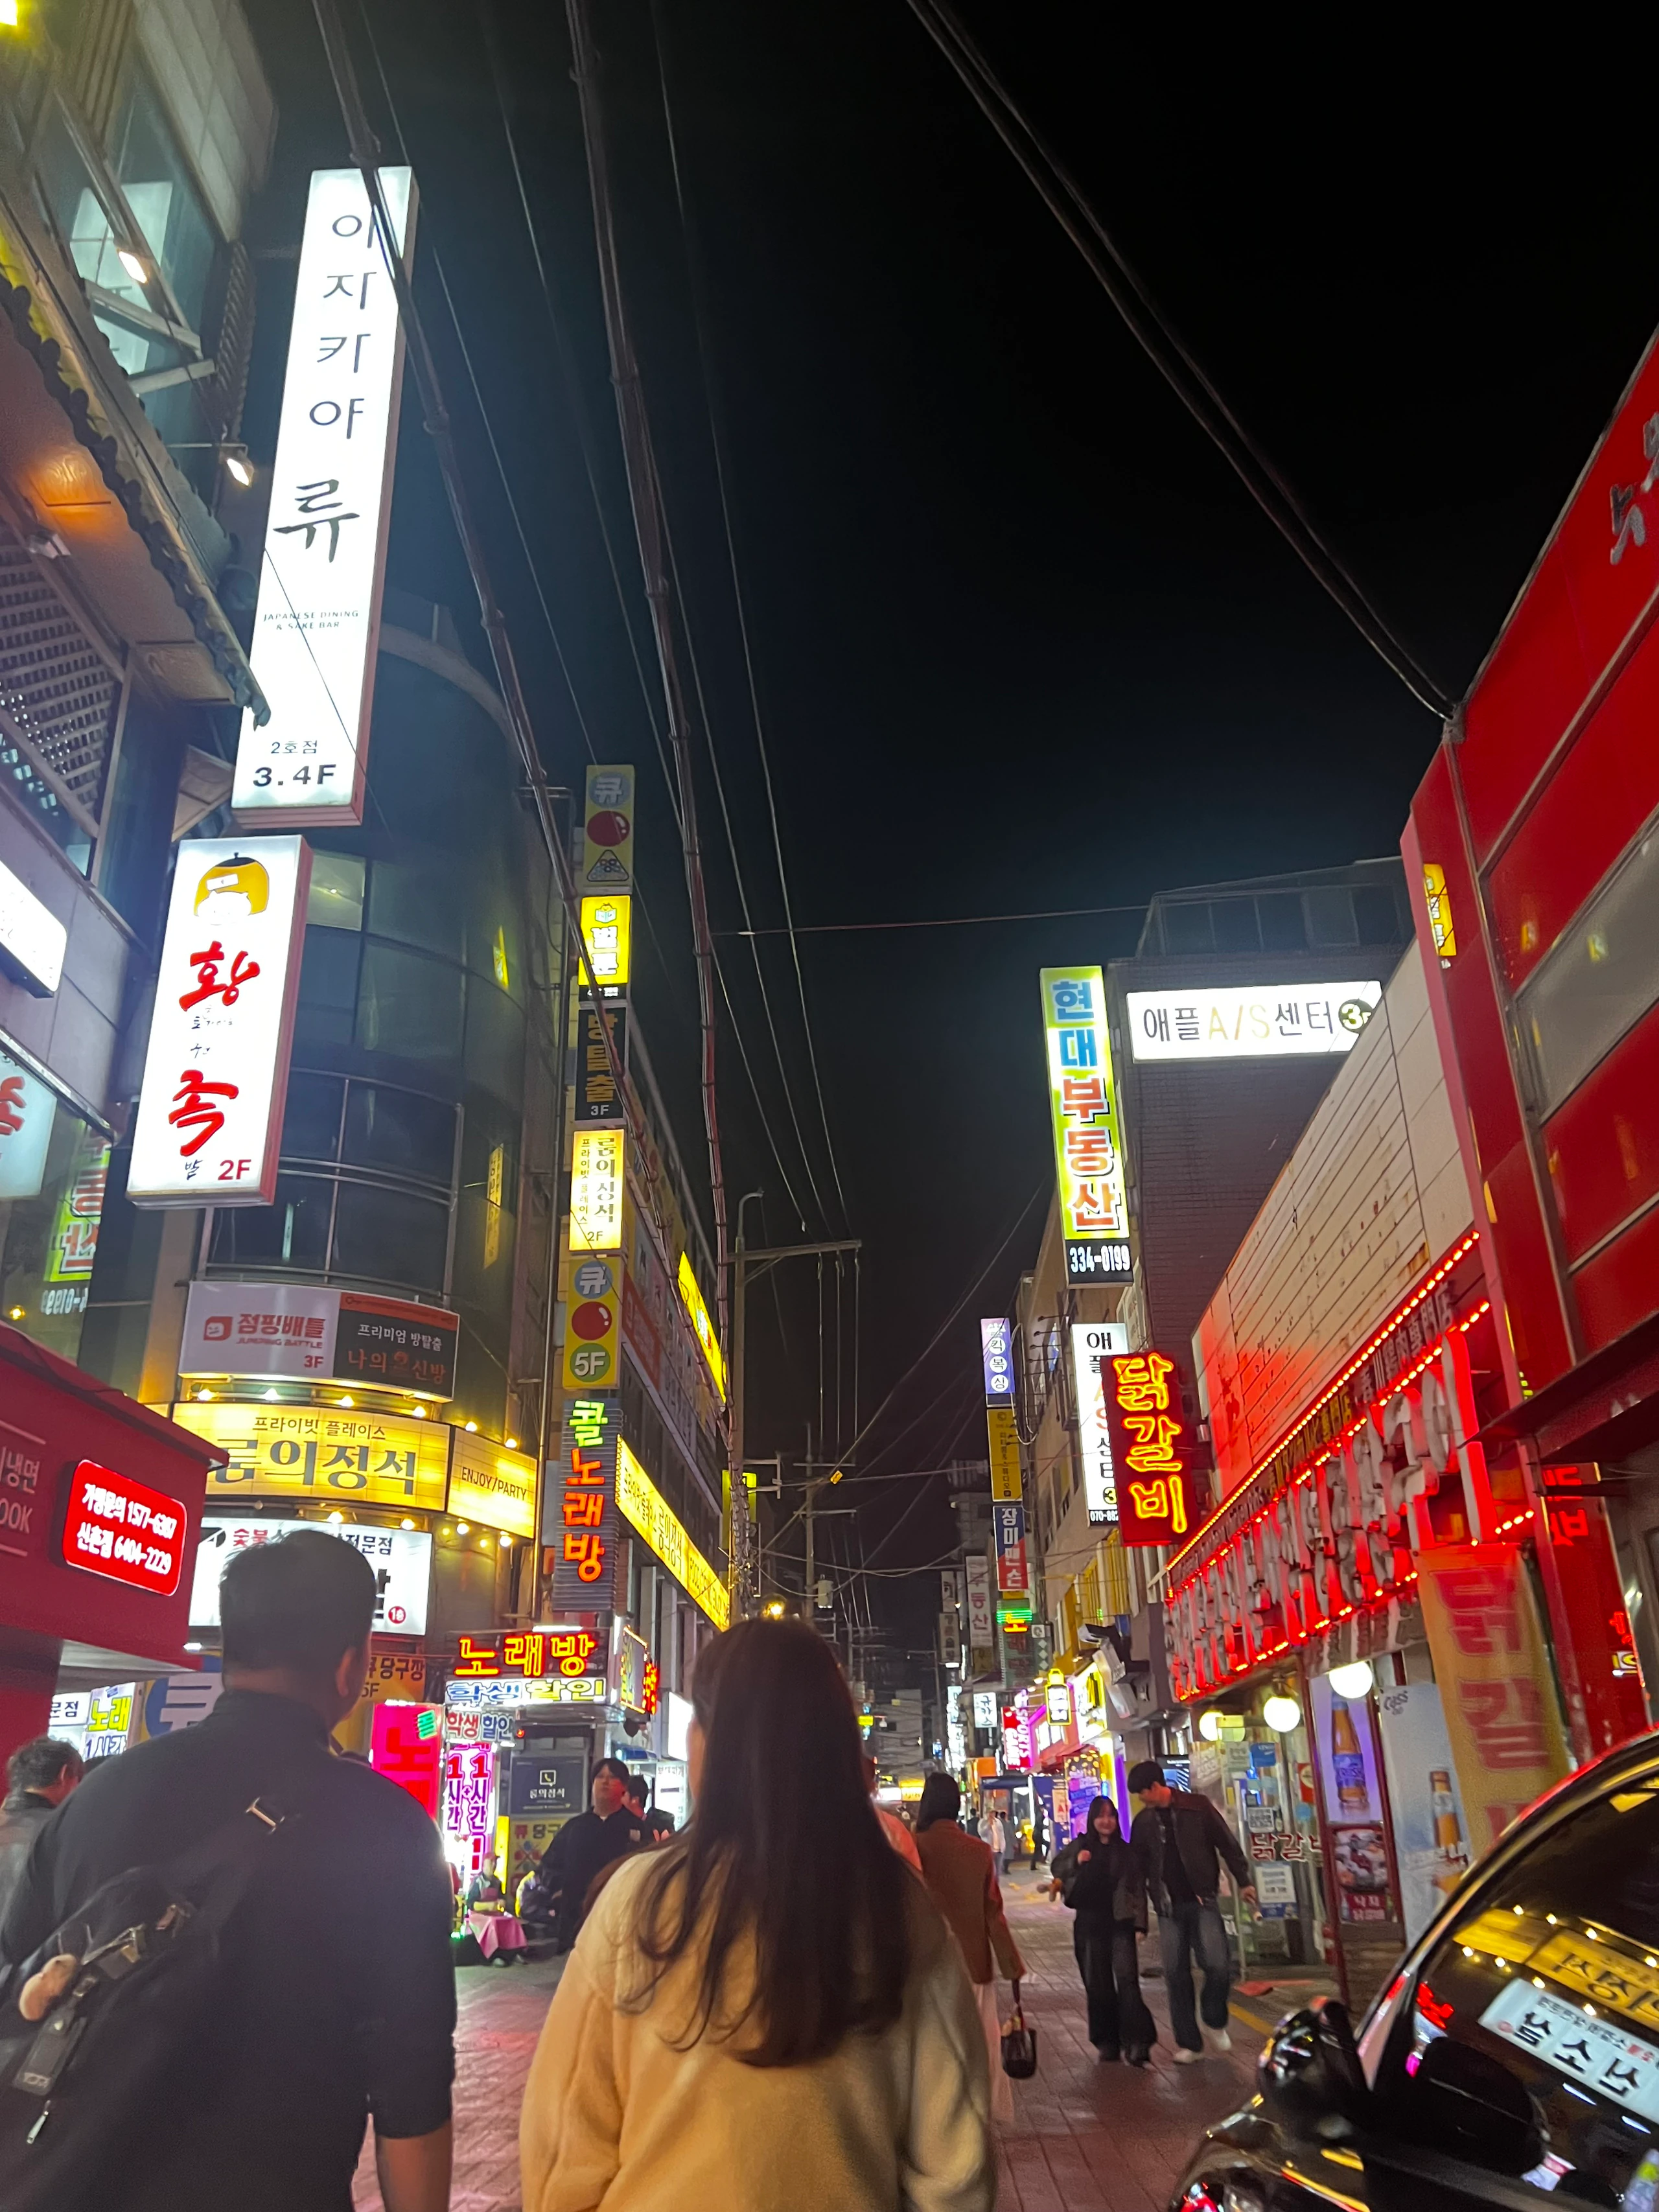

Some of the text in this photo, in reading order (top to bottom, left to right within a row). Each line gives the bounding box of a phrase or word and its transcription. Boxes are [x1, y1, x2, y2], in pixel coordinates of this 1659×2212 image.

[272, 214, 377, 563] 이자카야 류
[263, 610, 360, 622] JAPANESE DINING
[288, 622, 314, 631] SAKE
[319, 621, 340, 629] BAR
[270, 739, 318, 754] 2호점
[253, 763, 337, 787] 3.4F
[594, 778, 623, 804] 큐
[178, 940, 261, 1012] 황
[168, 1069, 240, 1157] 족
[590, 1104, 610, 1117] 3F
[1052, 981, 1116, 1229] 현대부동산
[218, 1158, 252, 1182] 2F
[594, 1137, 616, 1224] 룸의정석
[587, 1231, 603, 1242] 2F
[1069, 1244, 1130, 1274] 334-0199
[579, 1266, 608, 1296] 큐
[237, 1312, 327, 1339] 점핑배틀
[357, 1323, 443, 1353] 프리미엄 방탈출
[303, 1354, 324, 1369] 3F
[347, 1348, 388, 1373] 나의
[574, 1351, 607, 1377] 5F
[990, 1338, 1006, 1390] 킥복싱
[252, 1416, 387, 1441] 프라이빗 플레이스
[1112, 1353, 1188, 1534] 닭갈비
[0, 1446, 40, 1495] 냉면
[460, 1465, 528, 1500] ENJOY/PARTY
[562, 1448, 605, 1583] 노래방
[454, 1634, 596, 1677] 노래방
[448, 1679, 607, 1703] 학생 할인
[87, 1695, 133, 1732] 노래
[447, 1710, 516, 1742] 학생 할인
[85, 1735, 128, 1758] 1시간
[467, 1752, 490, 1831] 1시간
